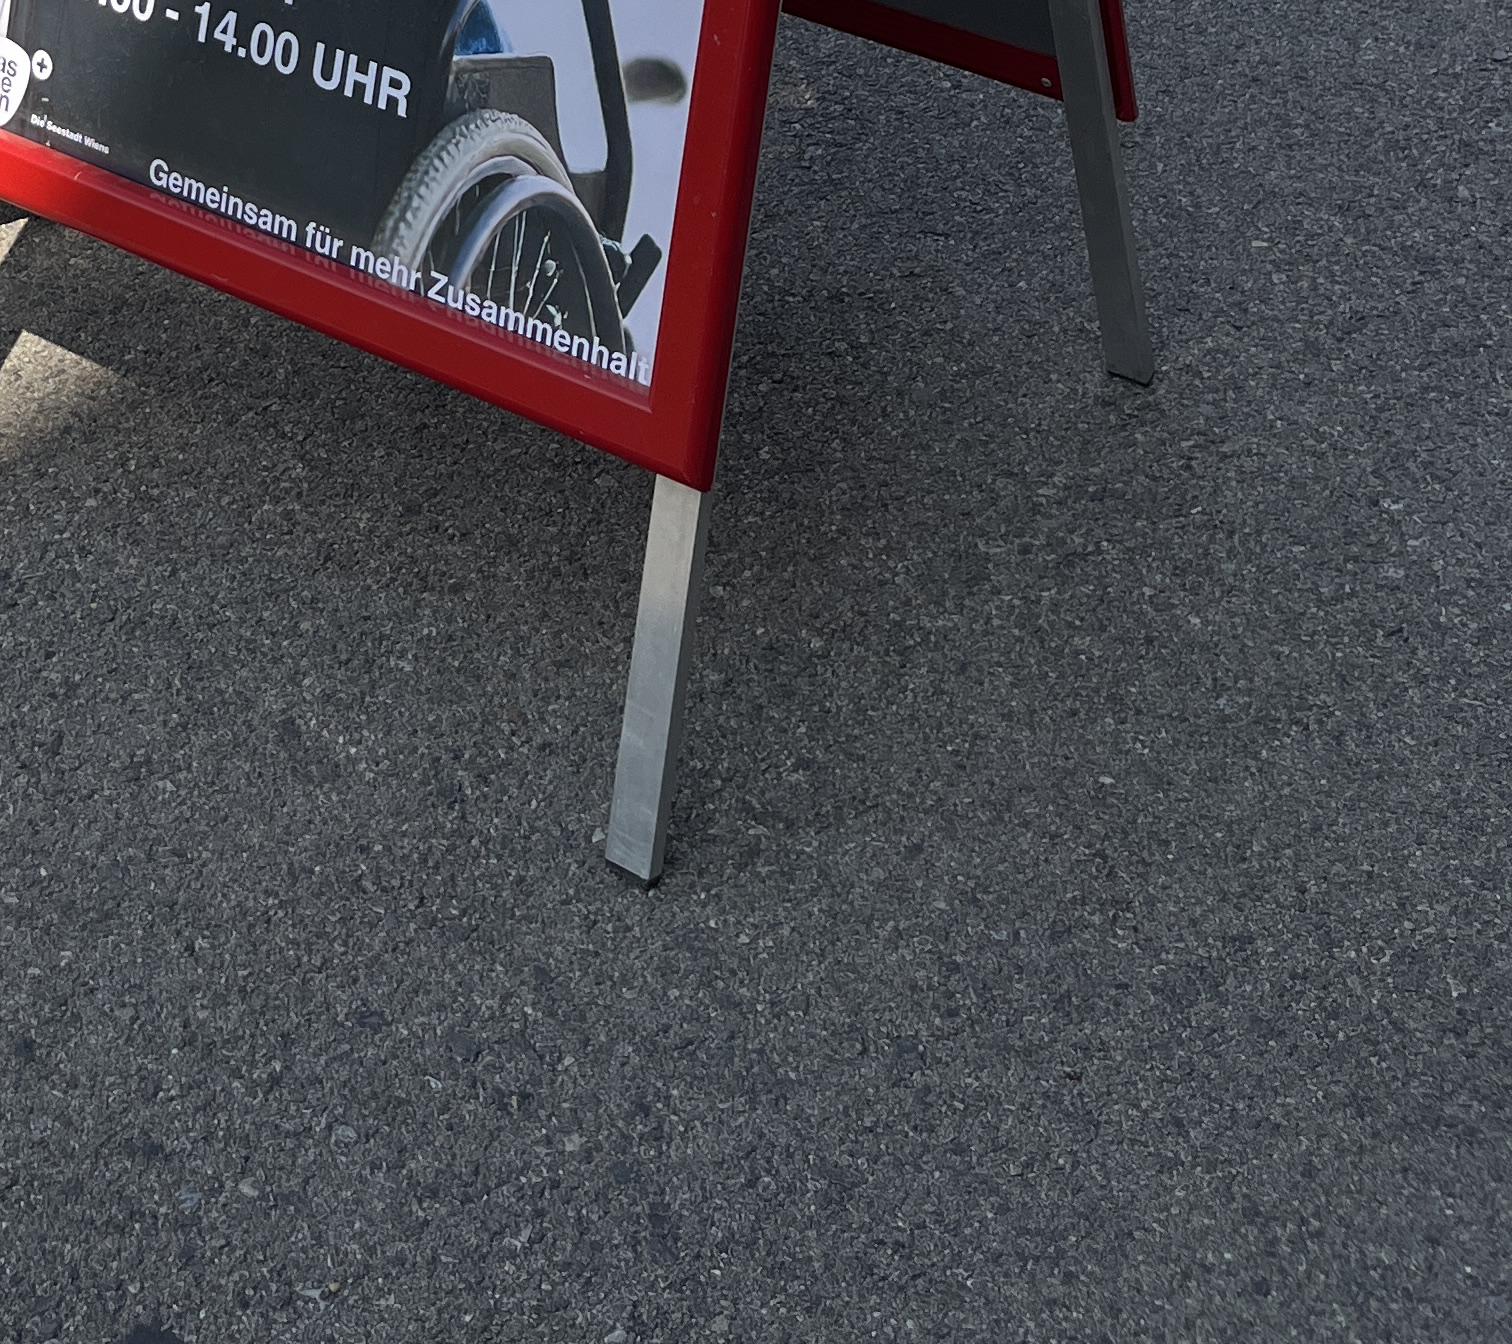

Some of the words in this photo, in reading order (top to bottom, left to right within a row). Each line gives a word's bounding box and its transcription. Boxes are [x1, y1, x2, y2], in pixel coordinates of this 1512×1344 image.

[193, 3, 300, 76] 14.00
[312, 41, 412, 118] UHR
[30, 113, 46, 128] Die
[46, 120, 83, 144] Seestadt
[83, 135, 110, 155] Wiens
[149, 158, 298, 242] Gemeinsam
[304, 221, 344, 259] für
[350, 245, 422, 291] mehr
[427, 270, 650, 388] Zusammenhalt
